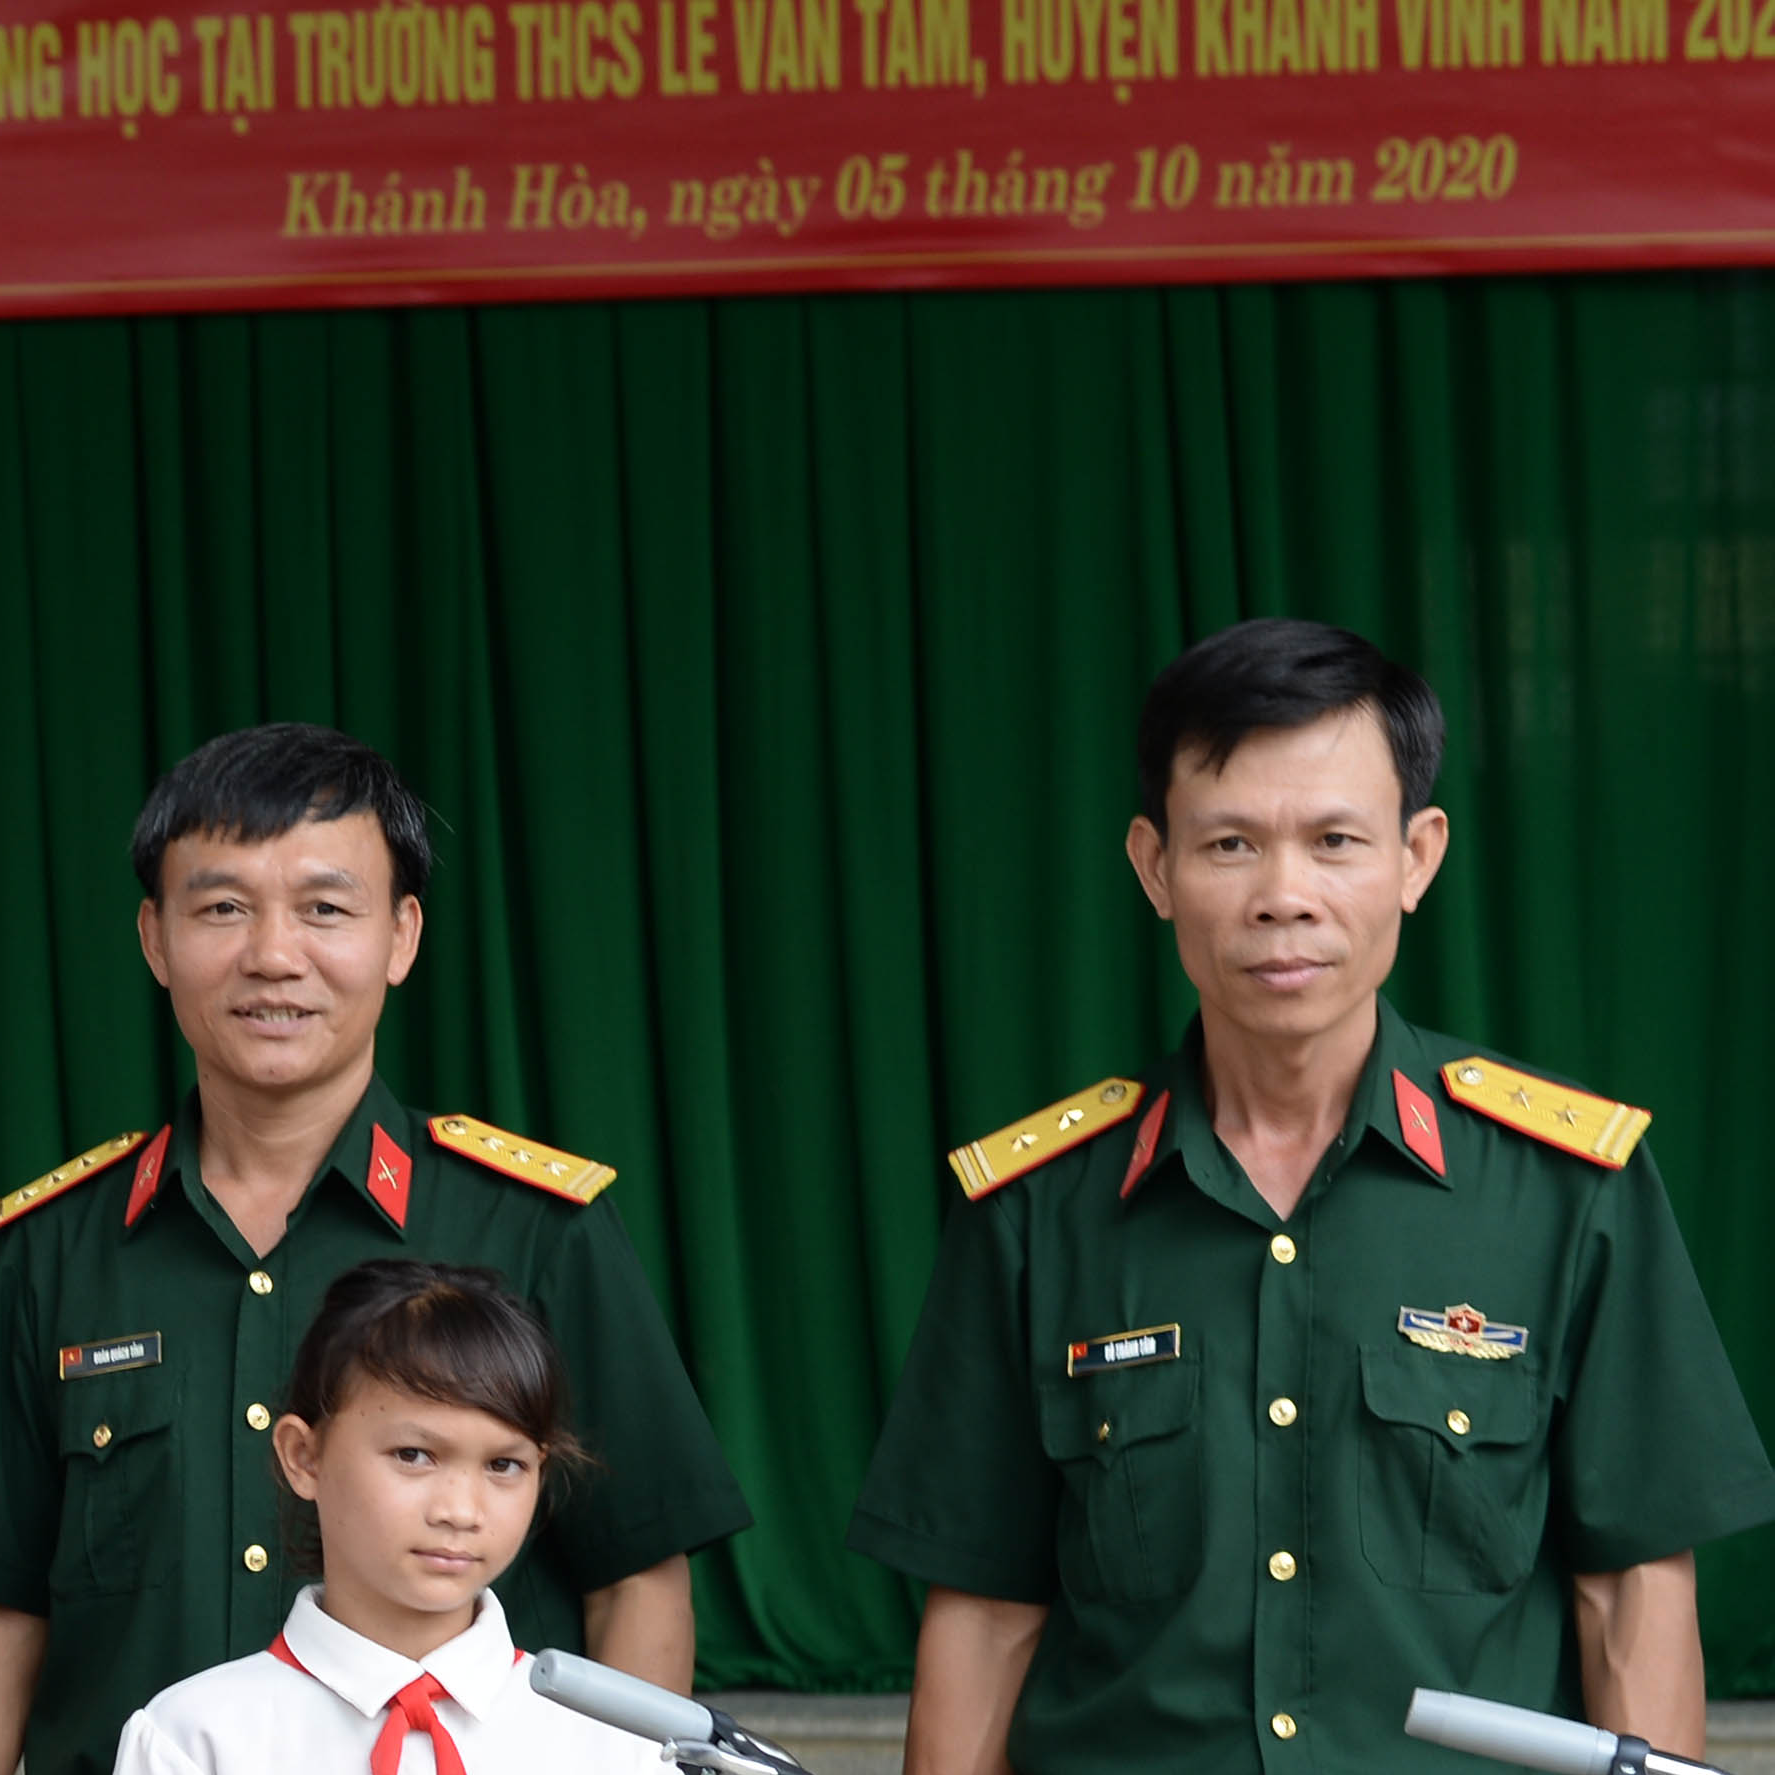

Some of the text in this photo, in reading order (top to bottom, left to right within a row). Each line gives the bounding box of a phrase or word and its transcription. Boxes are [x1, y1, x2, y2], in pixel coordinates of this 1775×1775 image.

[78, 17, 181, 138] HỌC
[194, 14, 275, 133] TẠI
[508, 0, 642, 100] THCS
[282, 135, 1519, 239] Khánh Hòa, ngày 05 tháng 10 năm 2020
